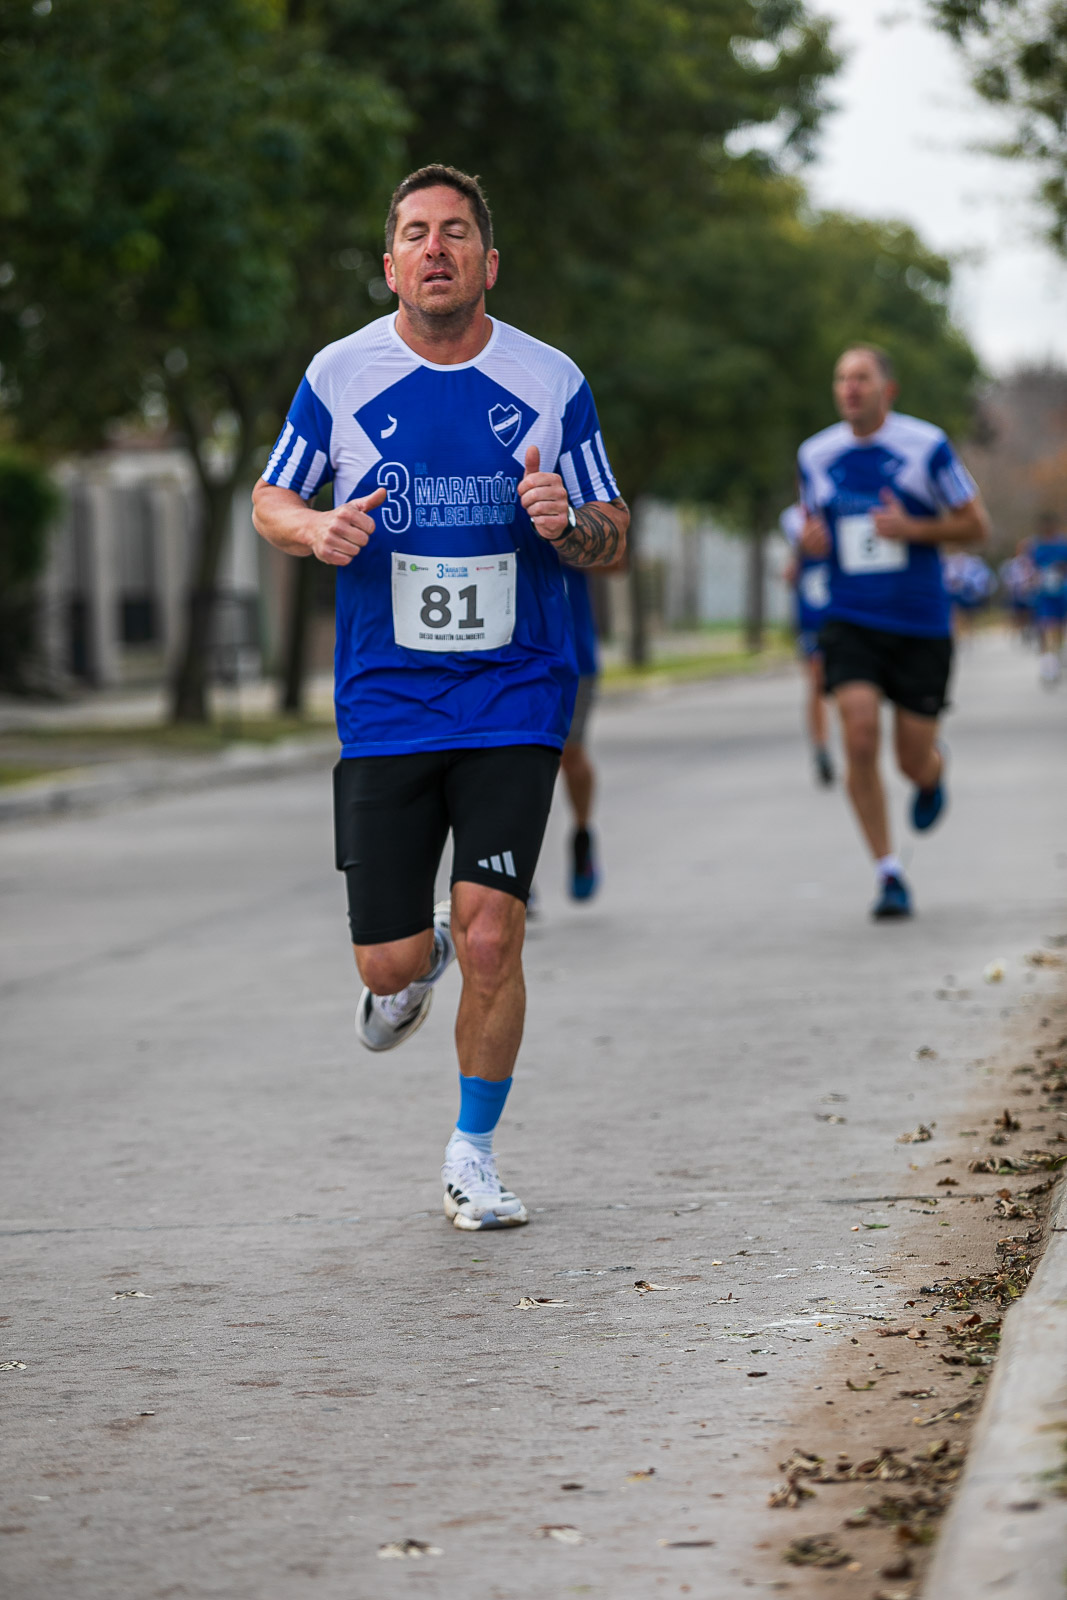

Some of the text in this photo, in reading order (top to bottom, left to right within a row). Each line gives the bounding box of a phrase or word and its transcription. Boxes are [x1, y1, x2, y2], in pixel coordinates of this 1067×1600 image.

[377, 462, 412, 533] 3
[414, 471, 518, 505] MARATÓN
[436, 563, 445, 579] 3
[420, 585, 484, 629] 81
